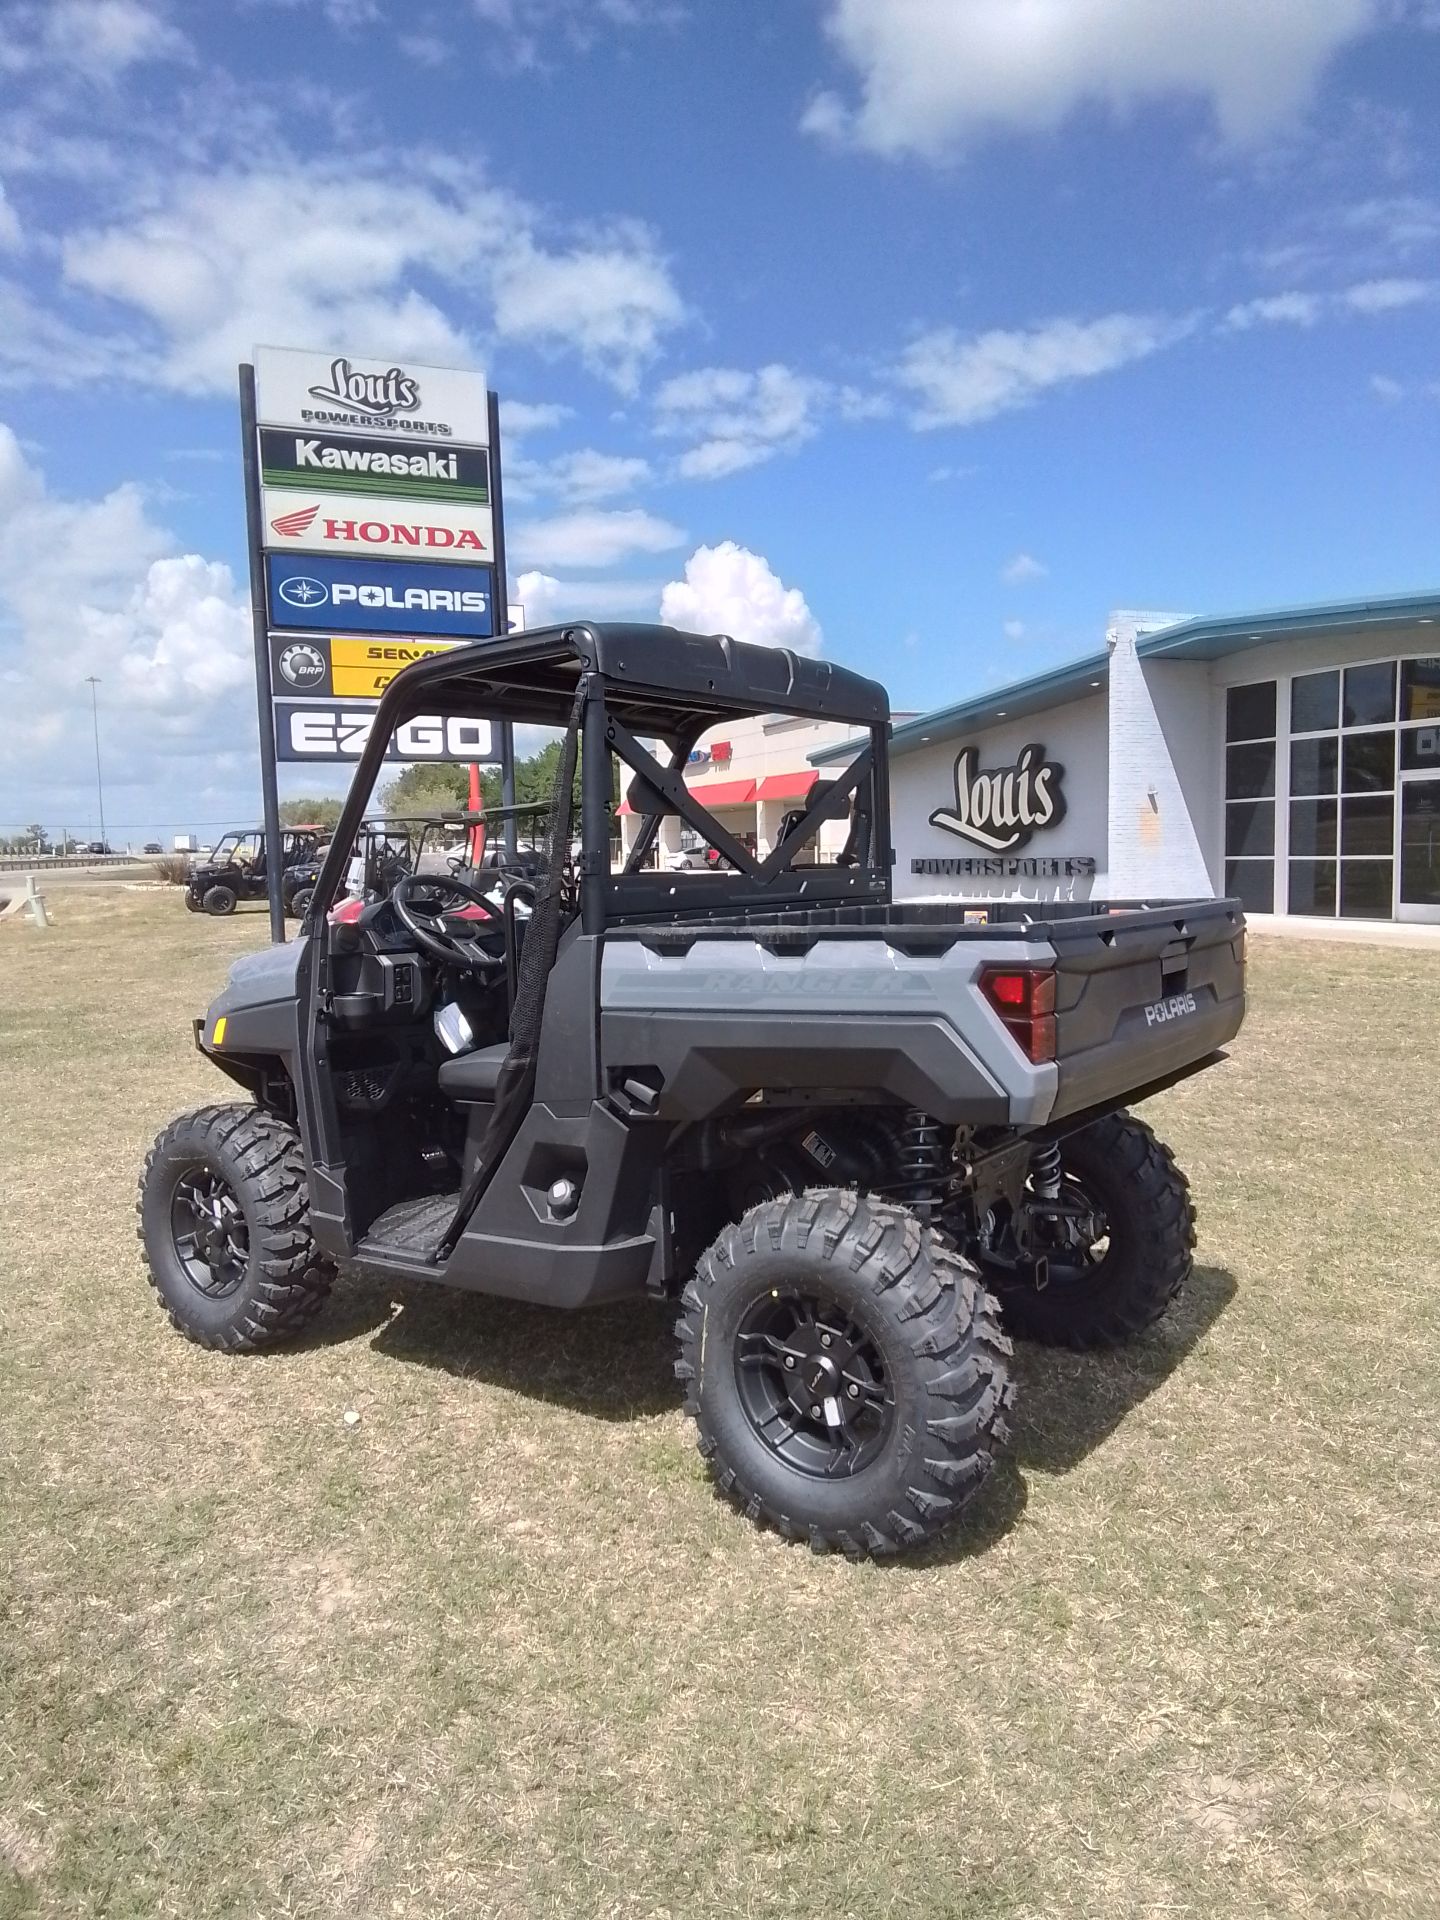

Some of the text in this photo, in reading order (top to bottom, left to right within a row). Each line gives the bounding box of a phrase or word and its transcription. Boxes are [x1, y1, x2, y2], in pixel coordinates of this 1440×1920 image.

[308, 357, 420, 416] Louis
[301, 409, 449, 433] POWERSPORTS
[295, 438, 458, 480] Kawasaki
[322, 518, 488, 550] HONDA
[331, 583, 486, 612] POLARIS
[298, 666, 323, 675] BRP
[928, 743, 1067, 853] Louis
[911, 857, 1096, 876] POWERSPORTS
[702, 971, 907, 992] RANGER
[1144, 992, 1197, 1026] POLARIS
